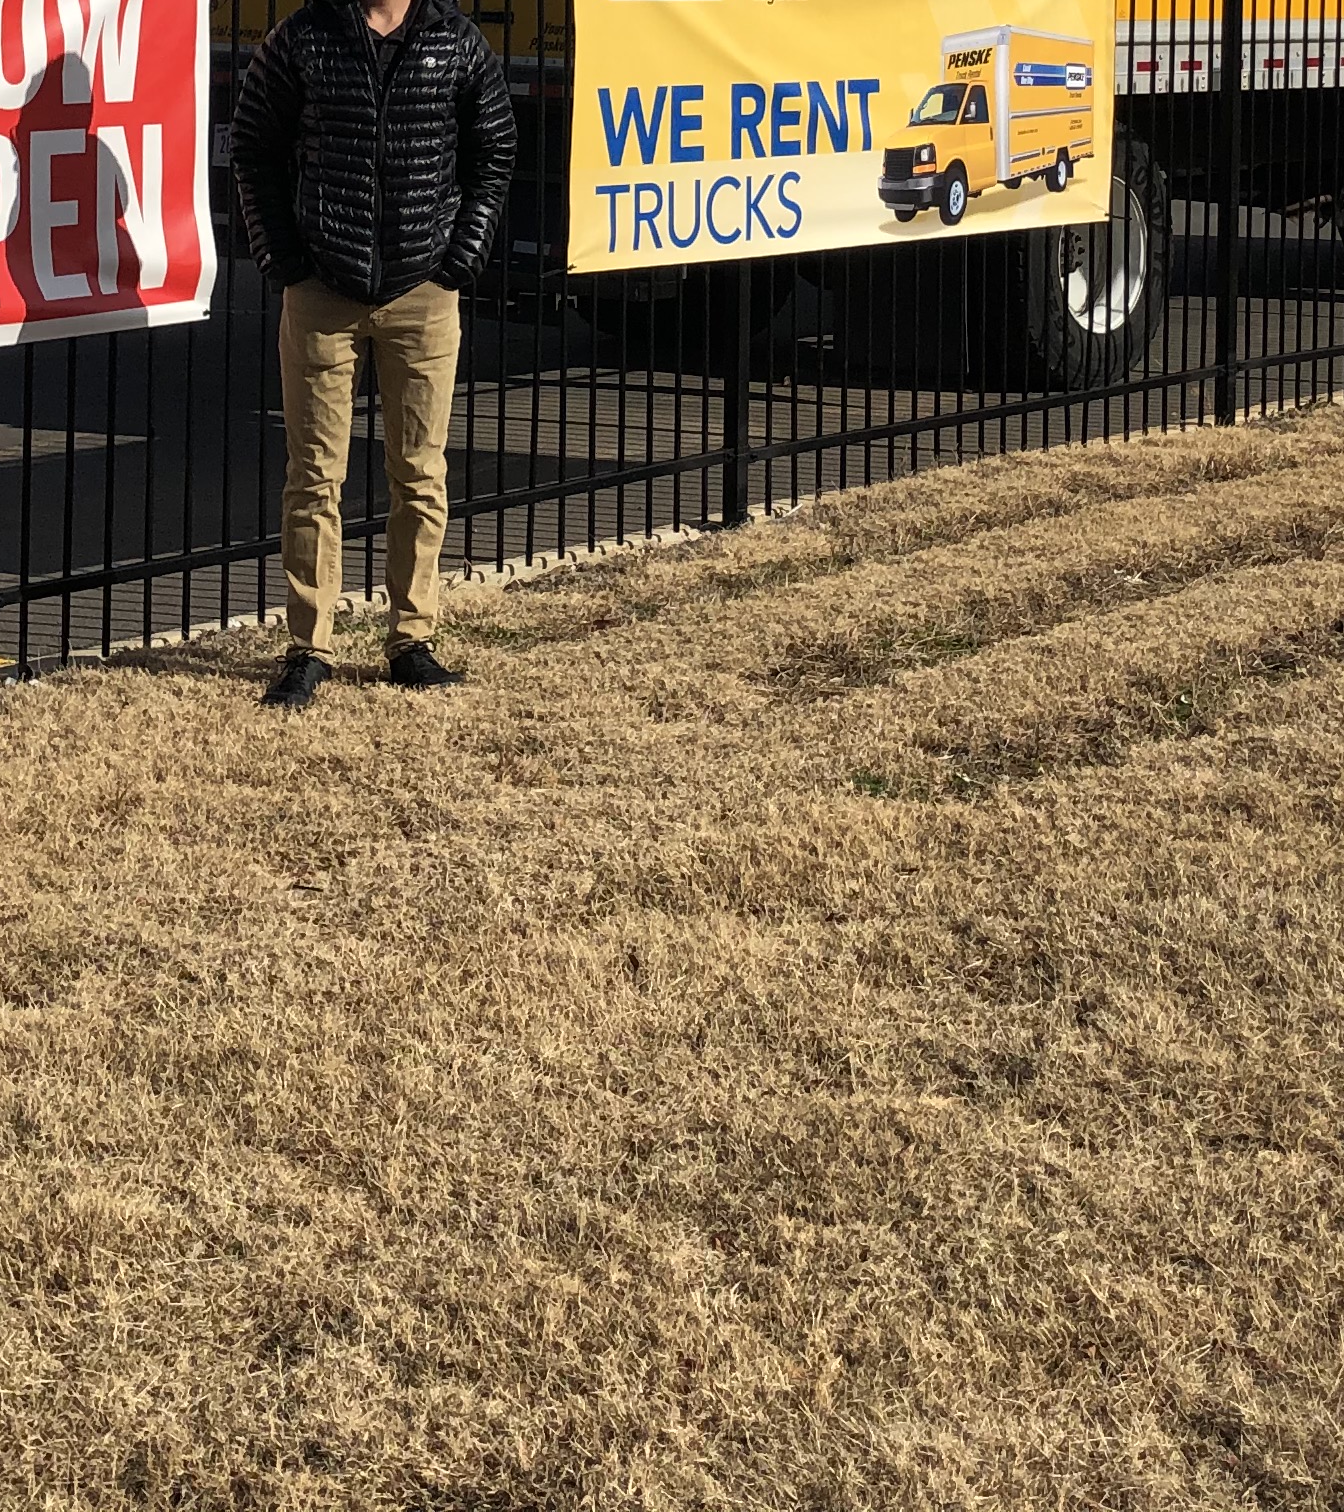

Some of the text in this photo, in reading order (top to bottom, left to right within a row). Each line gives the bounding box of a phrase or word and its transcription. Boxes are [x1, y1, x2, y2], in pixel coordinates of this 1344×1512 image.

[947, 48, 993, 70] PENSKE
[598, 78, 879, 166] WE RENT
[595, 171, 802, 253] TRUCKS
